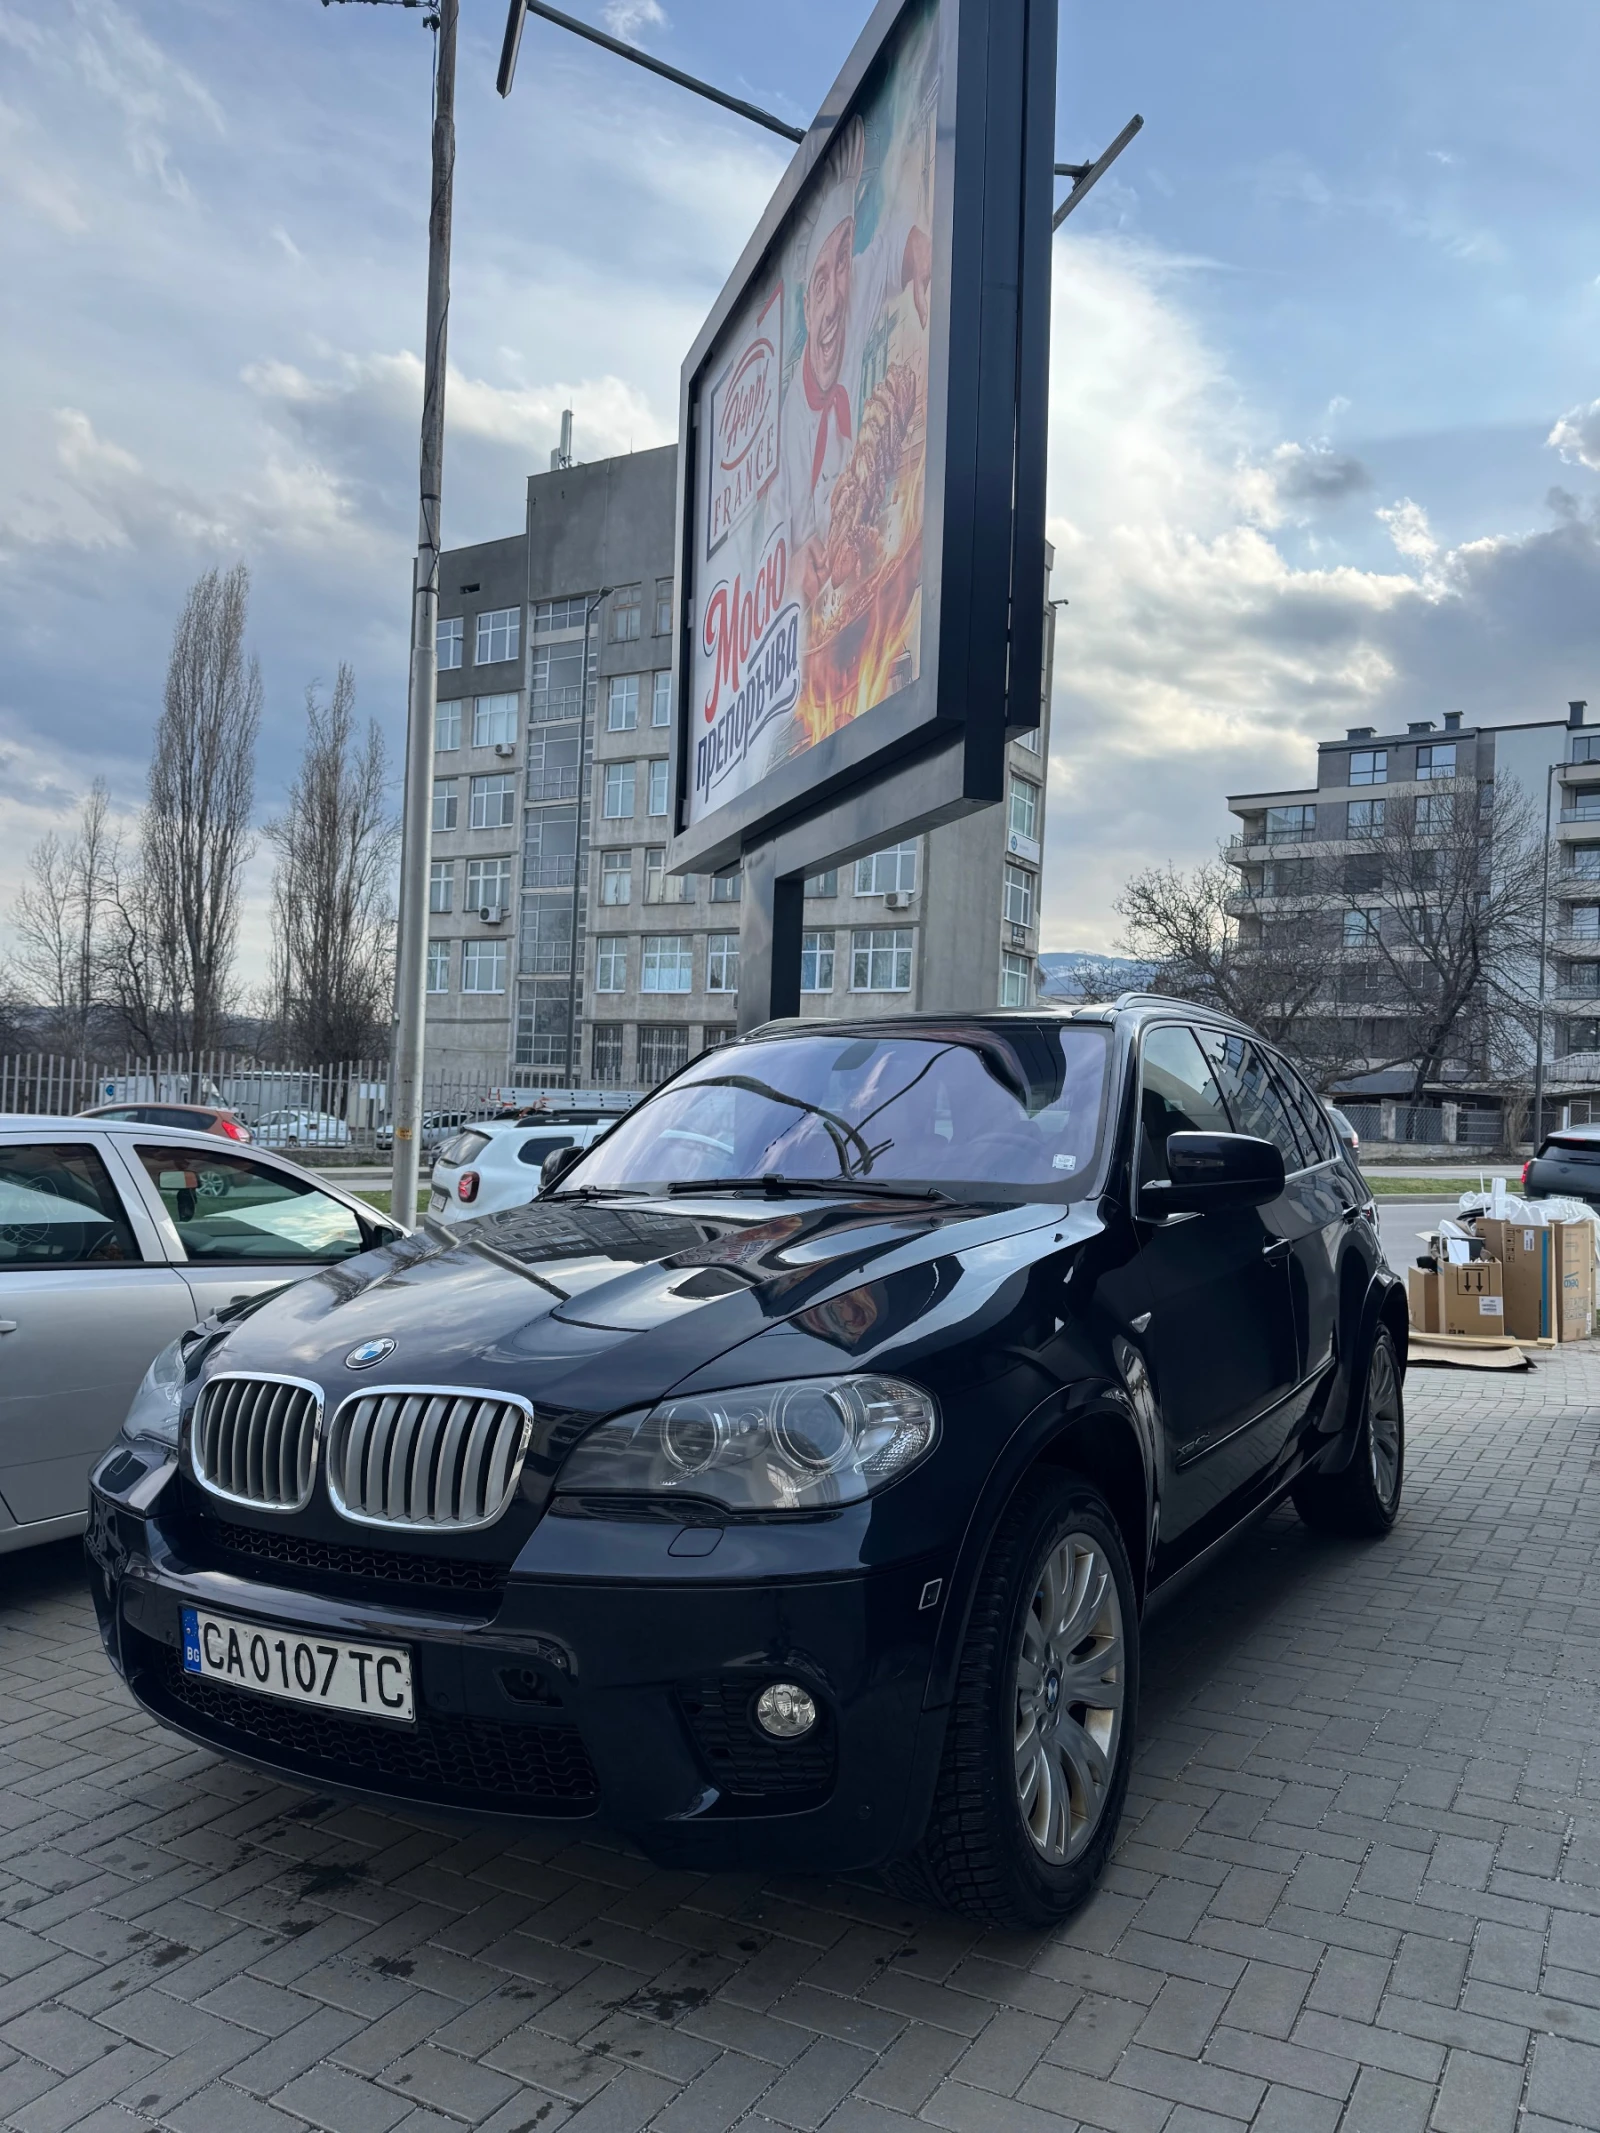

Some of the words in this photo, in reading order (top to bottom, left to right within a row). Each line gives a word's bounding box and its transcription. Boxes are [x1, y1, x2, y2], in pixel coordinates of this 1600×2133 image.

[723, 354, 771, 457] Happy
[713, 422, 775, 537] FRANCE
[186, 1646, 201, 1663] BG
